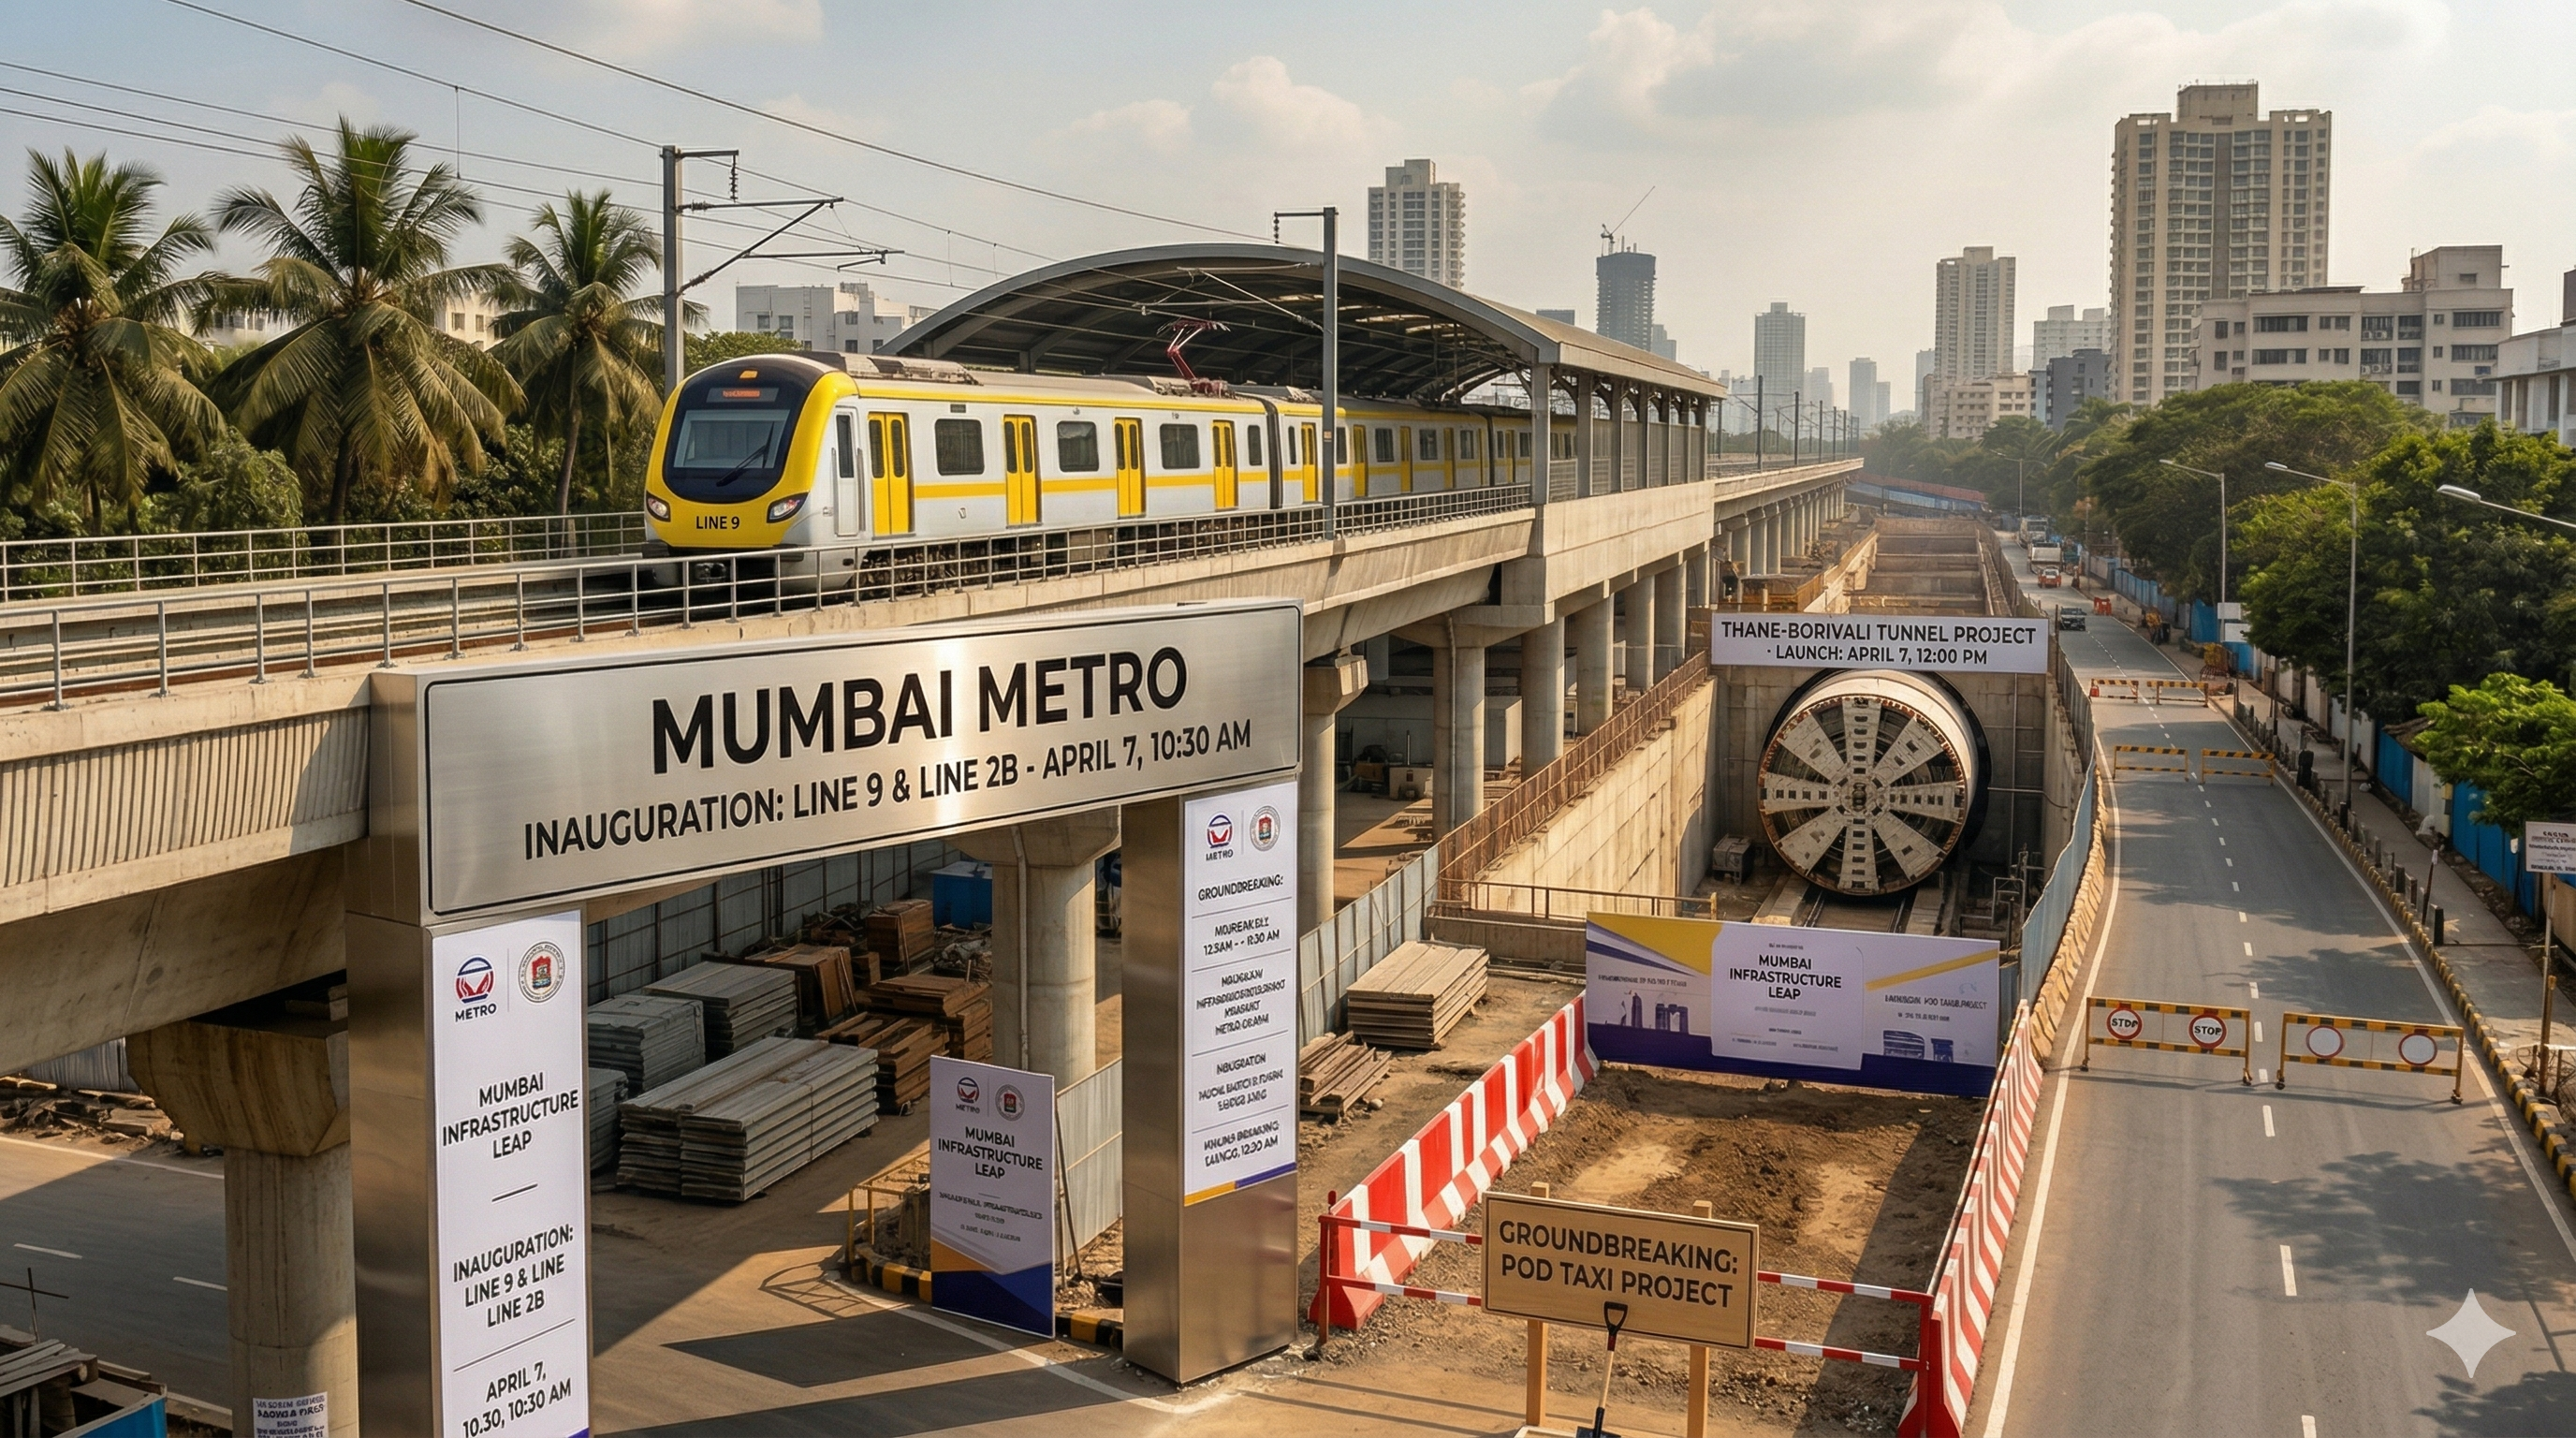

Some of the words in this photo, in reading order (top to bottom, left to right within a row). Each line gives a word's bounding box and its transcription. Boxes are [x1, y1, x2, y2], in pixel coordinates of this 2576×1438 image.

[695, 516, 727, 529] LINE
[731, 516, 739, 529] 9
[1720, 622, 1870, 640] THANE-BORIVALI
[1876, 624, 1949, 642] TUNNEL
[1954, 626, 2036, 644] PROJECT
[1776, 645, 1843, 660] LAUNCH:
[1847, 647, 1895, 662] APRIL
[1898, 648, 1912, 665] 7,
[1916, 648, 1957, 664] 12:00
[1963, 649, 1987, 665] PM
[652, 669, 953, 774] MUMBAI
[978, 646, 1187, 732] METRO
[525, 788, 783, 859] INAUGURATION:
[794, 776, 858, 818] LINE
[866, 772, 884, 807] 9
[892, 769, 911, 802] &
[920, 759, 978, 799] LINE
[986, 754, 1018, 787] 2B
[1043, 740, 1116, 780] APRIL
[1122, 735, 1142, 771] 7,
[1150, 725, 1209, 762] 10:30
[1216, 719, 1251, 754] AM
[1759, 954, 1811, 970] MUMBAI
[1729, 968, 1842, 989] INFRASTRUCTURE
[1768, 986, 1801, 1000] LEAP
[455, 1003, 497, 1022] METRO
[2194, 1025, 2222, 1035] STOP
[479, 1072, 544, 1108] MUMBAI
[443, 1089, 579, 1147] INFRASTRUCTURE
[492, 1130, 532, 1159] LEAP
[965, 1126, 1015, 1148] MUMBAI
[1264, 1135, 1279, 1150] AM
[938, 1138, 1043, 1170] INFRASTRUCTURE
[975, 1163, 1005, 1179] LEAP
[453, 1223, 574, 1283] INAUGURATION:
[1500, 1220, 1738, 1274] GROUNDBREAKING:
[465, 1276, 500, 1308] LINE
[504, 1272, 513, 1294] 9
[518, 1268, 528, 1288] &
[532, 1254, 565, 1284] LINE
[1501, 1254, 1553, 1282] POD
[1559, 1261, 1613, 1291] TAXI
[1621, 1270, 1734, 1308] PROJECT
[487, 1298, 521, 1328] LINE
[526, 1289, 545, 1313] 2B
[486, 1367, 531, 1402] APRIL
[534, 1360, 546, 1381] 7,
[462, 1408, 505, 1438] 10.30,
[508, 1389, 545, 1421] 10:30
[549, 1377, 571, 1404] AM
